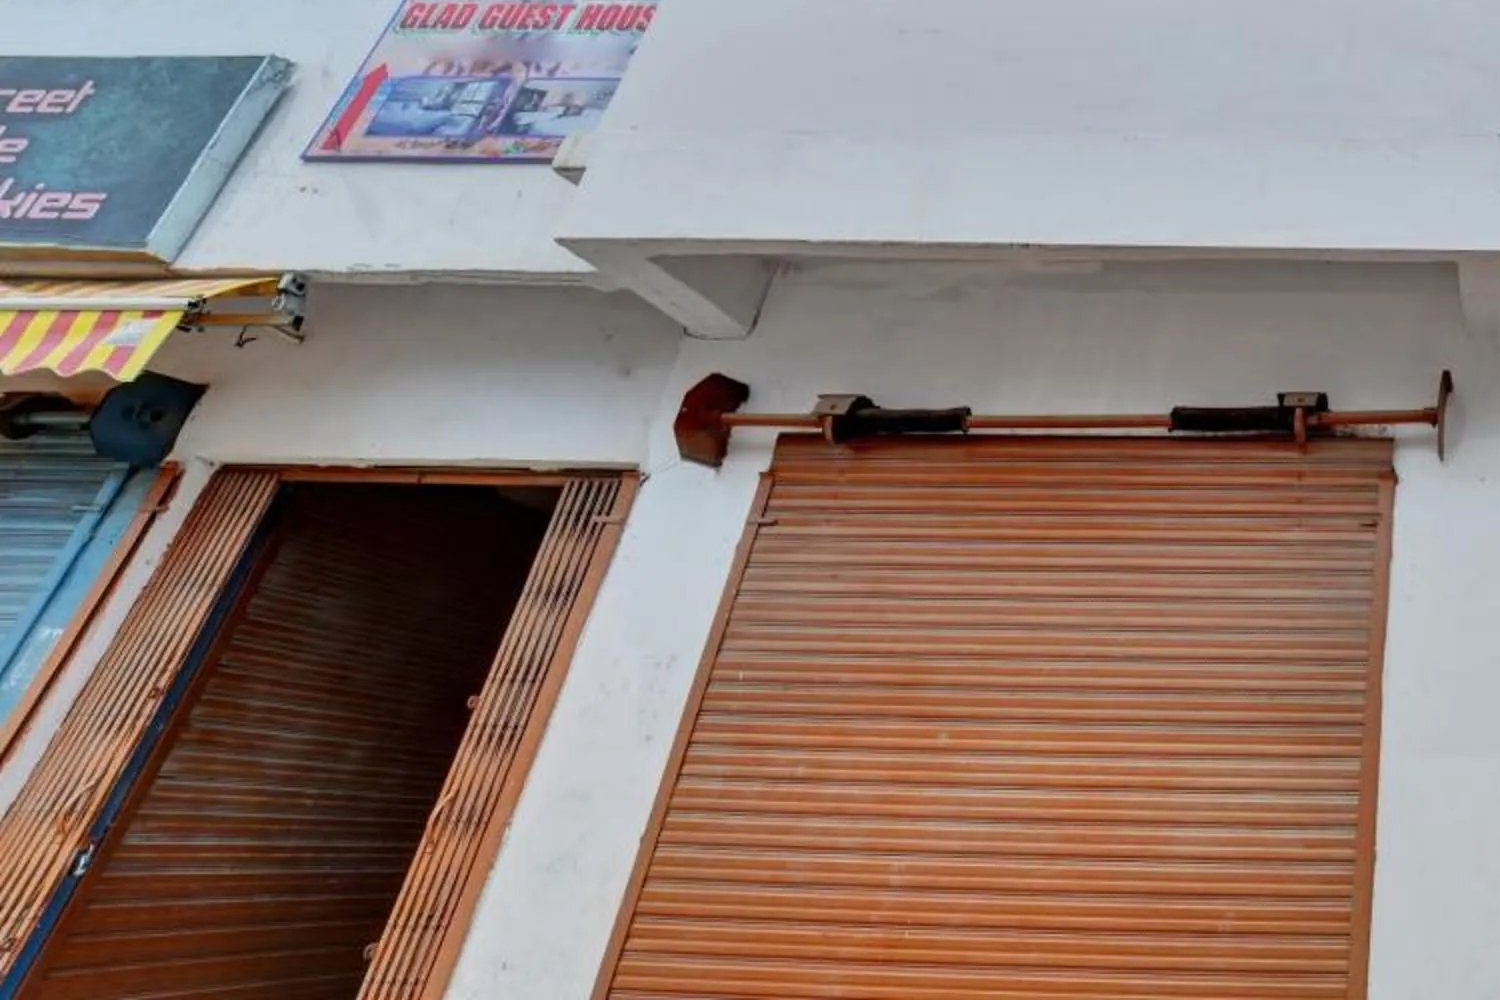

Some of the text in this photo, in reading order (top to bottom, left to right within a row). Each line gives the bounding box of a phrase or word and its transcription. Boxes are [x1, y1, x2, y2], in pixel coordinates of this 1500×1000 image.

[400, 3, 657, 33] GLAD GUEST HOUS
